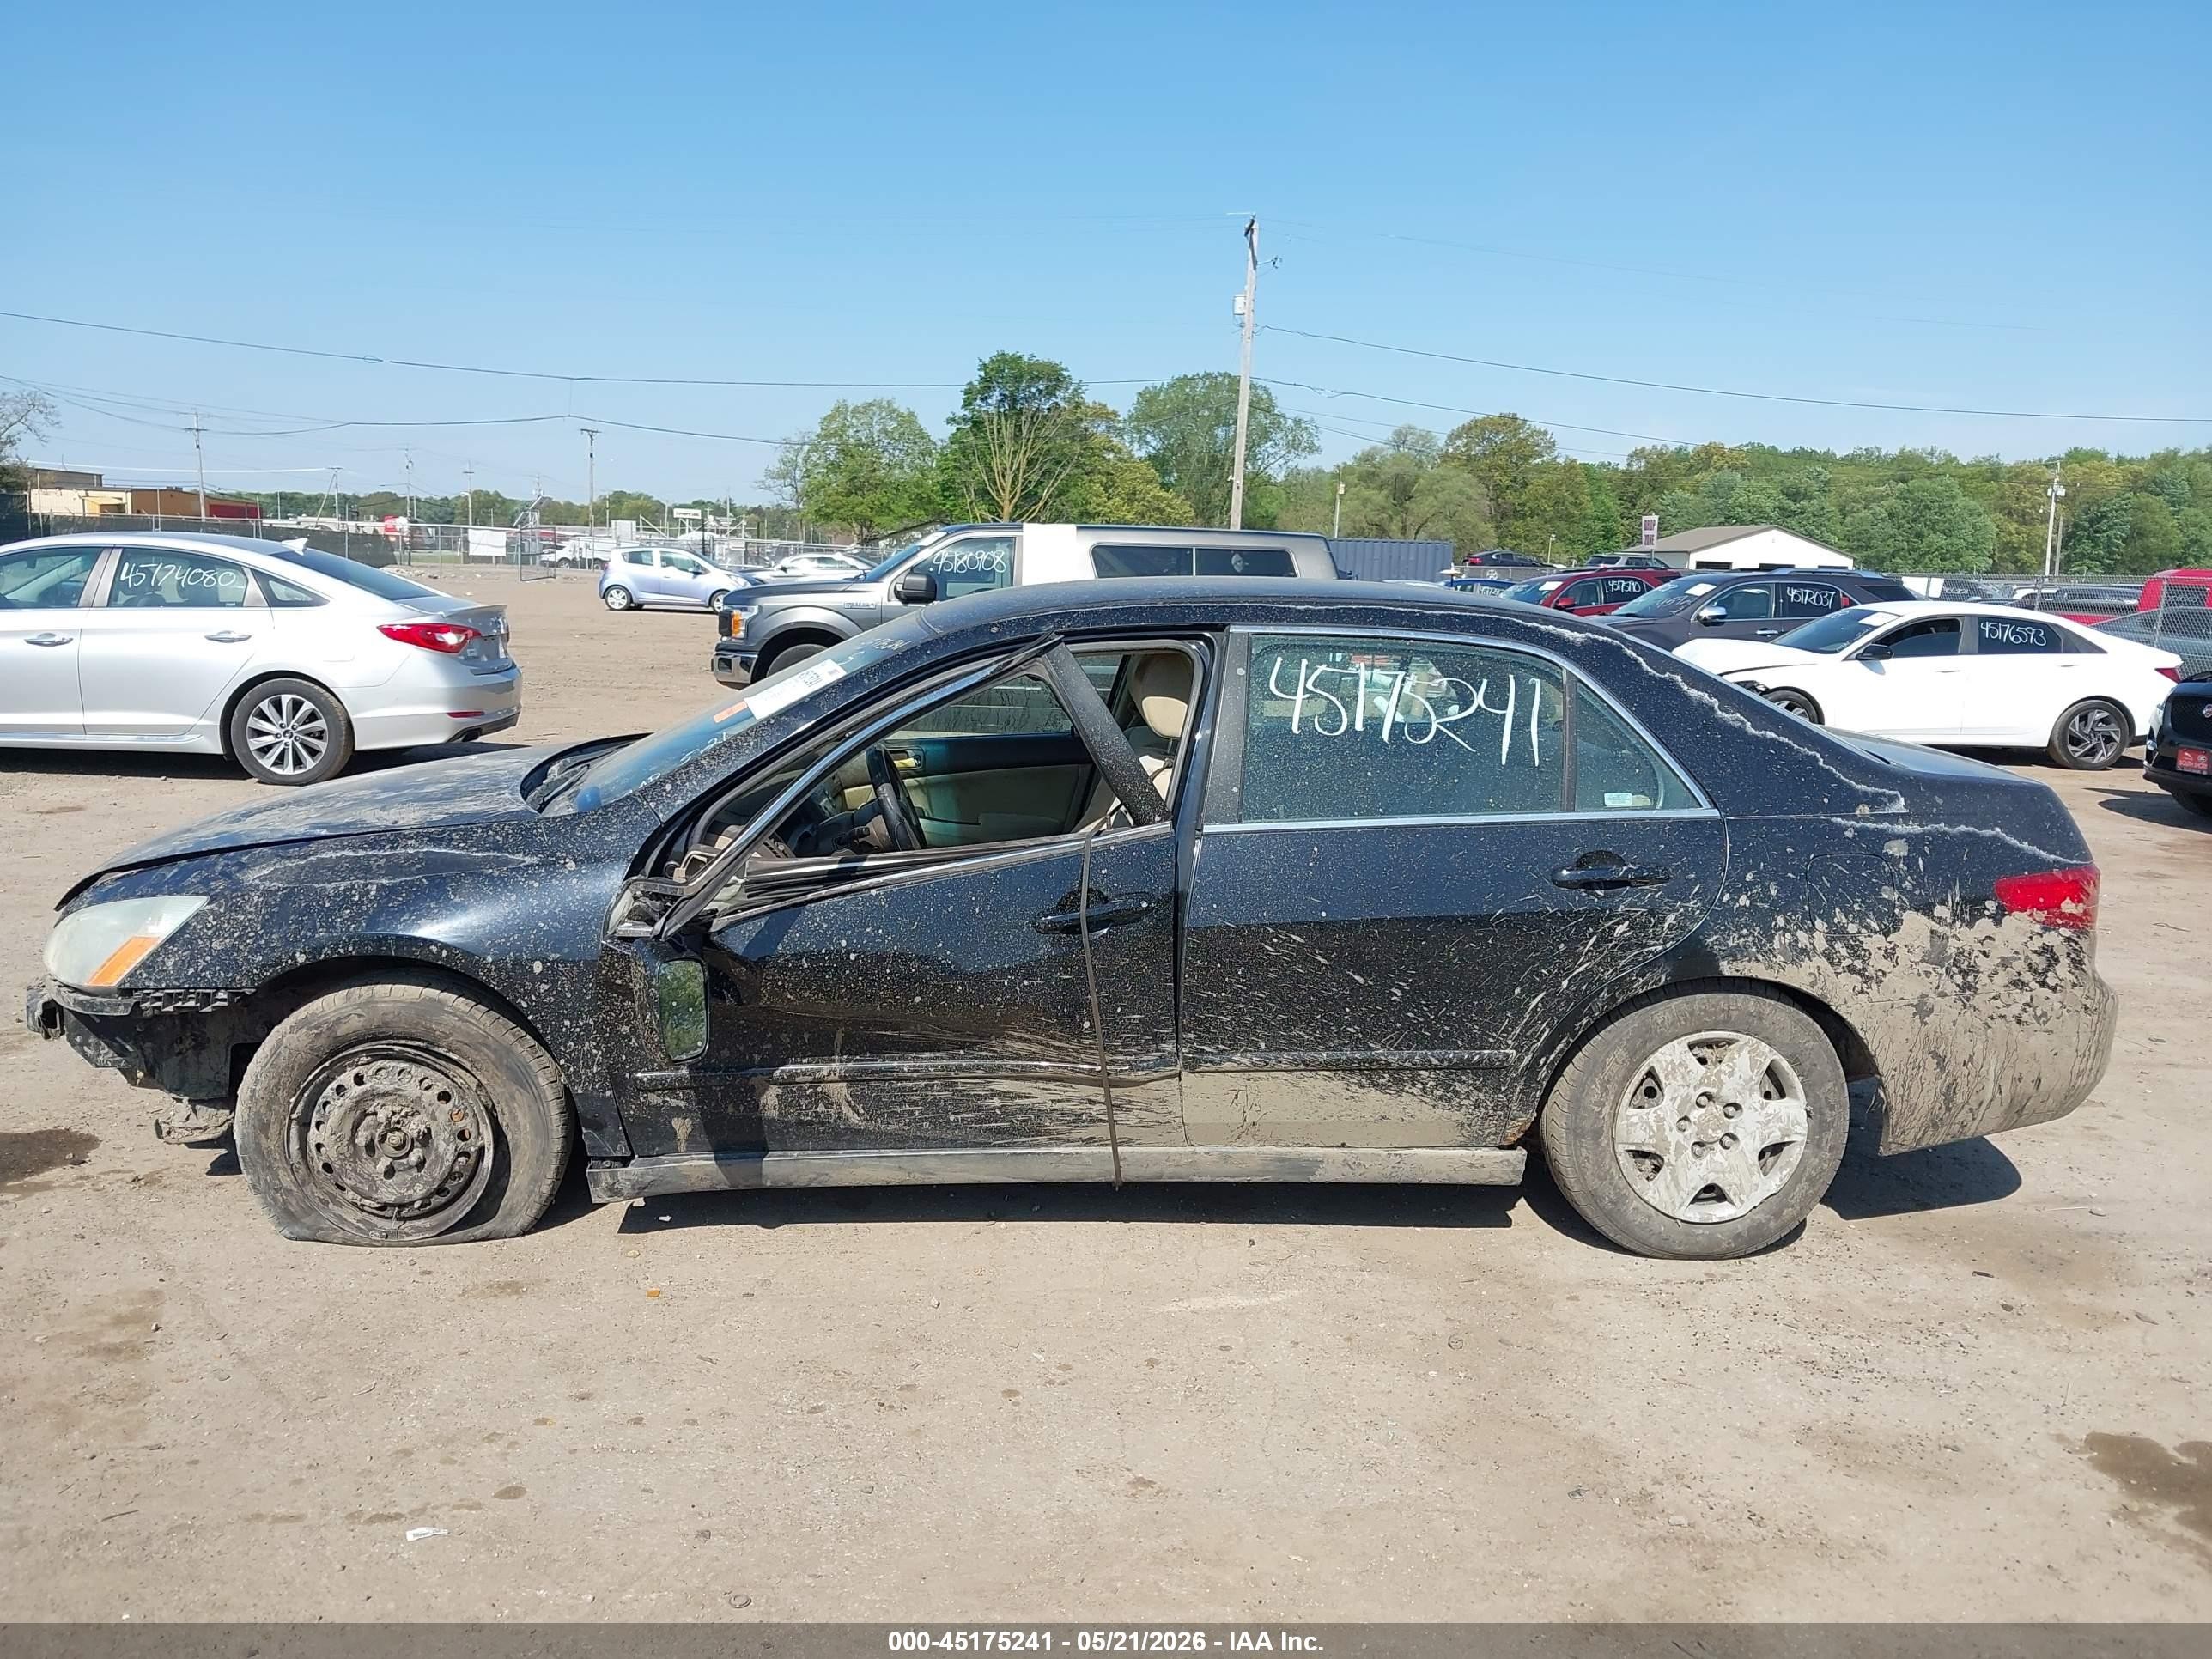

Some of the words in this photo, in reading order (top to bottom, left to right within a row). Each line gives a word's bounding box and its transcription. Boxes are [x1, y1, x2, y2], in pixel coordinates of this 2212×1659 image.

[120, 562, 236, 588] 45174080
[1980, 621, 2047, 647] 45176593
[1269, 656, 1541, 767] 45175241
